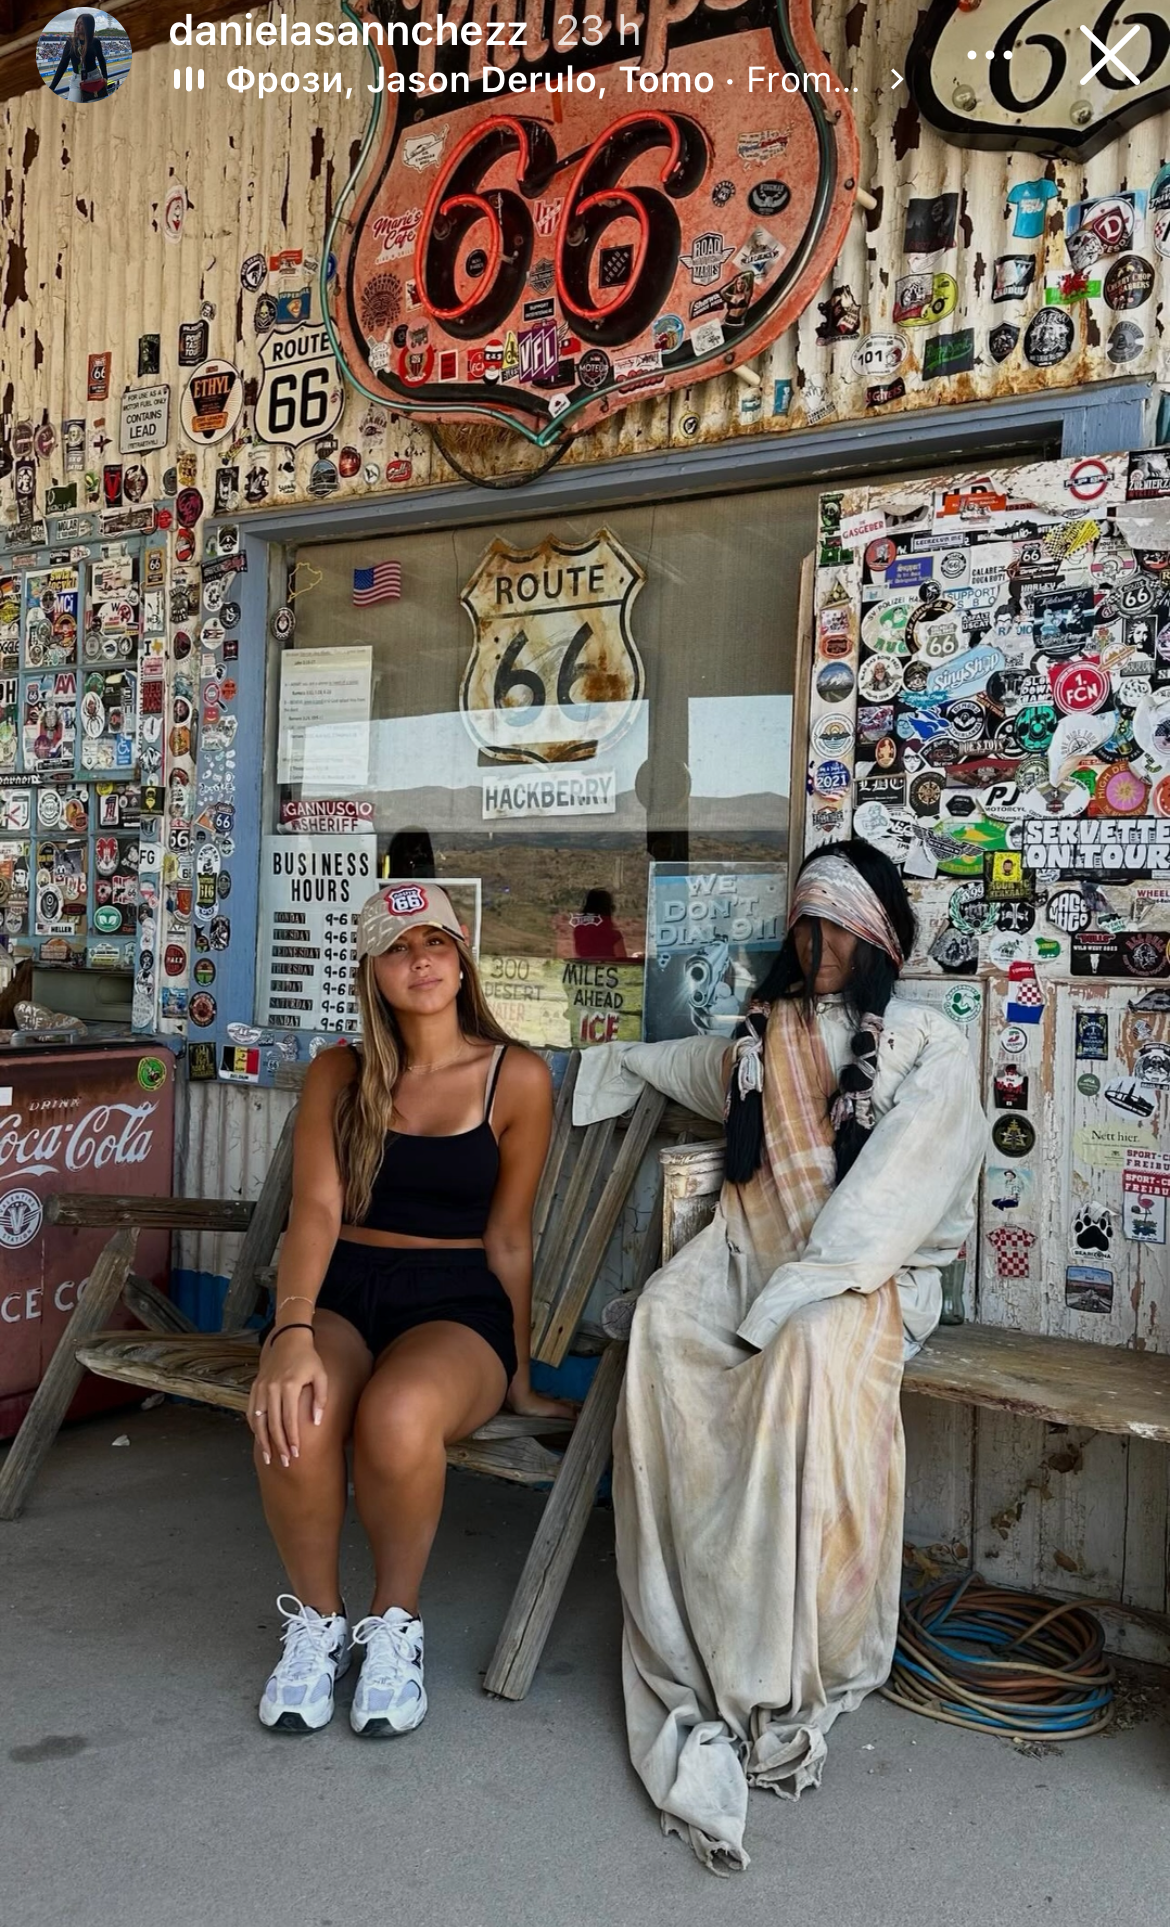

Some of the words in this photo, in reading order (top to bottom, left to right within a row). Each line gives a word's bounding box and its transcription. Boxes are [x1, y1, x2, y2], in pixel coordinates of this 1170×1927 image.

[989, 0, 1170, 113] 66
[374, 208, 422, 233] Marie's
[415, 110, 708, 346] 66
[694, 235, 720, 257] ROAD
[272, 332, 330, 362] ROUTE
[520, 327, 556, 380] VFL
[858, 350, 883, 367] 101
[128, 392, 138, 401] FOR
[149, 390, 157, 398] AS
[192, 375, 230, 399] ETHYL
[123, 402, 140, 412] MOTOR
[140, 400, 153, 409] FUEL
[153, 397, 167, 406] ONLY
[269, 367, 330, 435] 66
[126, 410, 162, 425] CONTAINS
[130, 423, 157, 439] LEAD
[842, 521, 884, 540] GASGEBER
[1022, 550, 1040, 561] 66
[150, 559, 160, 570] 66
[496, 564, 605, 605] ROUTE
[947, 586, 995, 601] SUPPORT
[1125, 586, 1149, 607] 66
[877, 596, 906, 613] POLIZEI
[930, 635, 955, 656] 66
[494, 622, 607, 727] 66
[1075, 673, 1087, 686] 1.
[29, 690, 38, 700] 66
[1066, 683, 1098, 705] FCN
[816, 774, 847, 788] 2021
[1098, 773, 1111, 799] HIGH
[486, 776, 613, 811] HACKBERRY
[286, 801, 373, 816] GANNUSCIO
[215, 813, 231, 829] 66
[301, 818, 359, 833] SHERIFF
[1026, 819, 1170, 845] SERVETTE
[140, 849, 155, 865] FG
[273, 852, 369, 877] BUSINESS
[1026, 844, 1071, 869] ON
[1079, 845, 1170, 869] TOUR
[291, 878, 350, 902] HOURS
[685, 873, 738, 897] WE
[1137, 889, 1170, 898] WHEEL
[395, 895, 421, 911] 66
[664, 894, 760, 923] DON'T
[325, 913, 348, 926] 9-6
[324, 931, 347, 944] 9-6
[732, 916, 778, 942] 911
[324, 948, 347, 961] 9-6
[324, 965, 347, 978] 9-6
[490, 958, 530, 981] 300
[562, 963, 619, 989] MILES
[323, 982, 346, 995] 9-6
[485, 982, 545, 1002] DESERT
[321, 1000, 345, 1014] 9-6
[573, 989, 623, 1009] AHEAD
[18, 1003, 39, 1016] RAY
[320, 1017, 344, 1031] 9-6
[580, 1012, 620, 1042] ICE
[29, 1097, 81, 1111] DRINK
[1092, 1130, 1116, 1142] Nett
[1117, 1131, 1141, 1143] hier.
[2, 1229, 33, 1243] STATION
